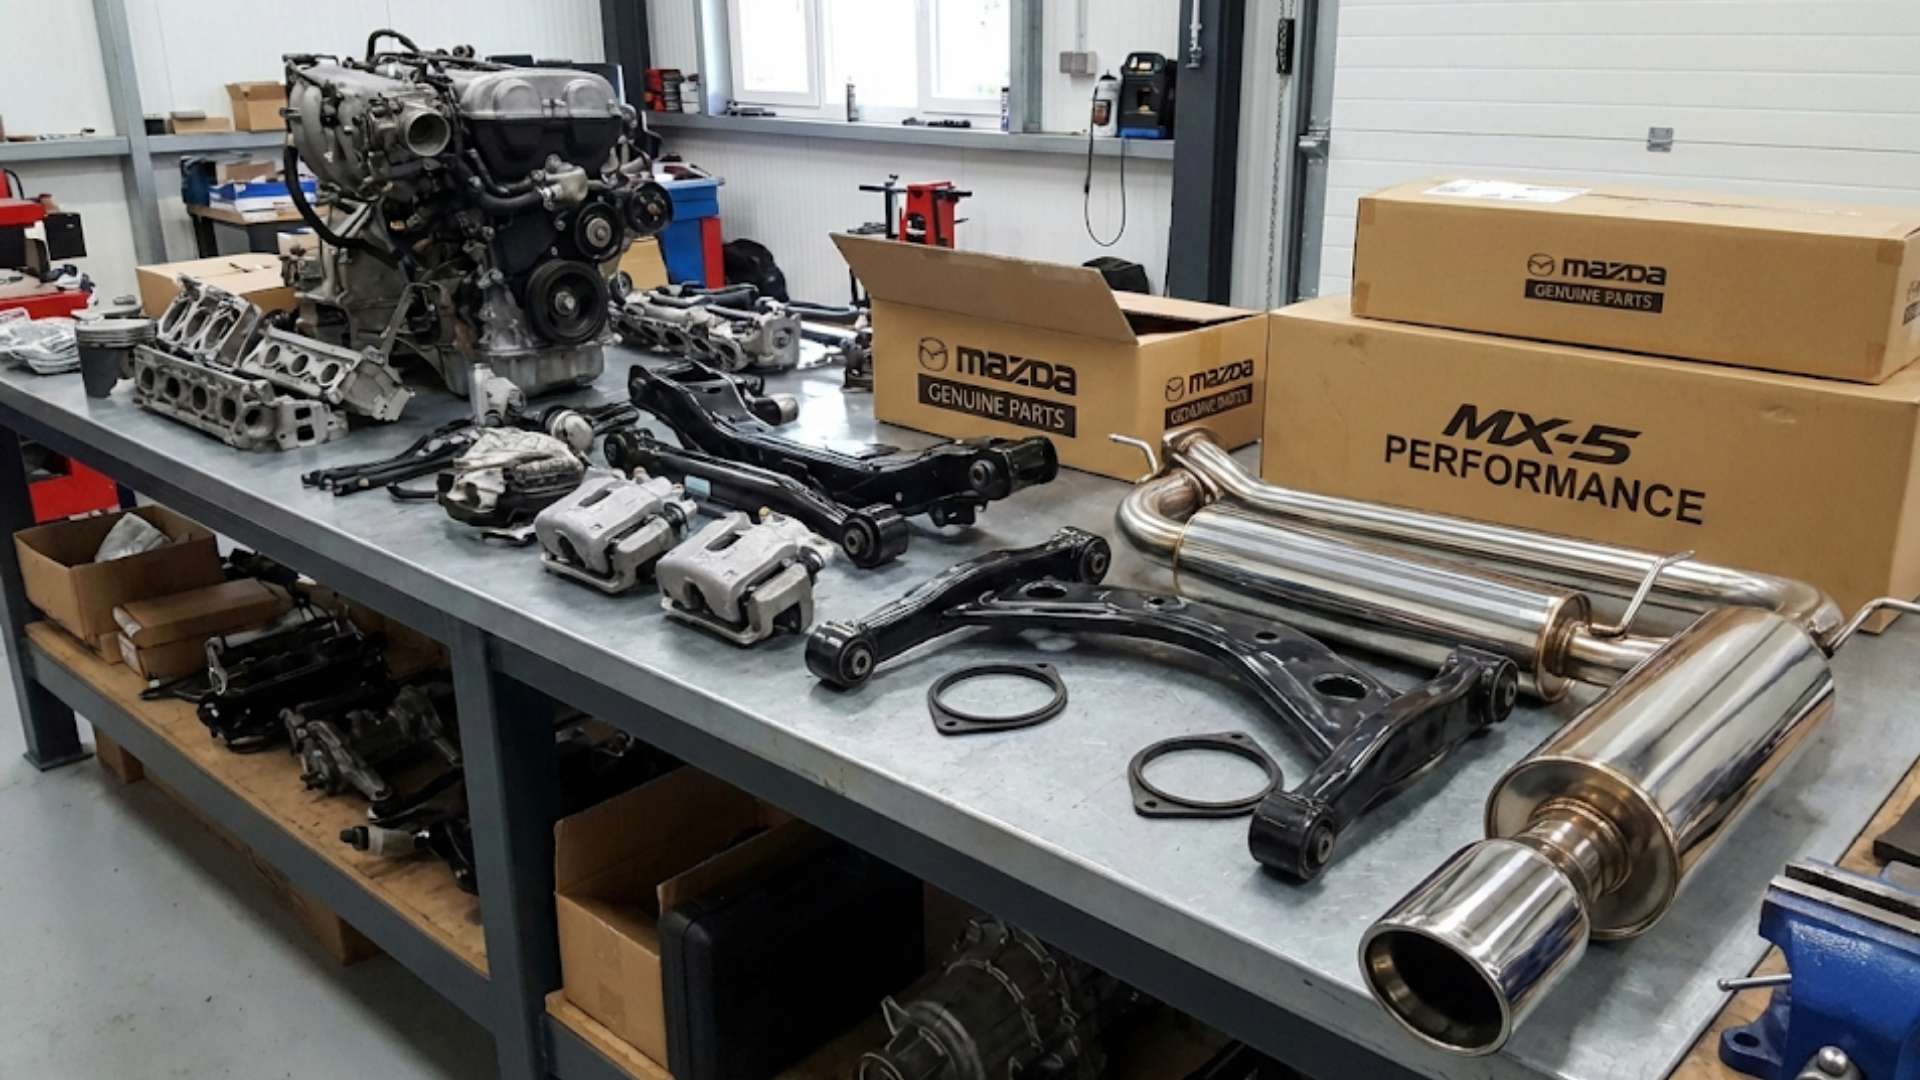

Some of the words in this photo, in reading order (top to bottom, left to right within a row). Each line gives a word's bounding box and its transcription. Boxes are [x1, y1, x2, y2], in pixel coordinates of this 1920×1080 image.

[1562, 257, 1667, 286] mazda
[1534, 284, 1601, 304] GENUINE
[1605, 290, 1654, 309] PARTS
[956, 345, 1077, 396] mazda
[928, 382, 1005, 417] GENUINE
[1009, 399, 1066, 429] PARTS
[1442, 403, 1643, 465] MX-5
[1384, 433, 1706, 526] PERFORMANCE
